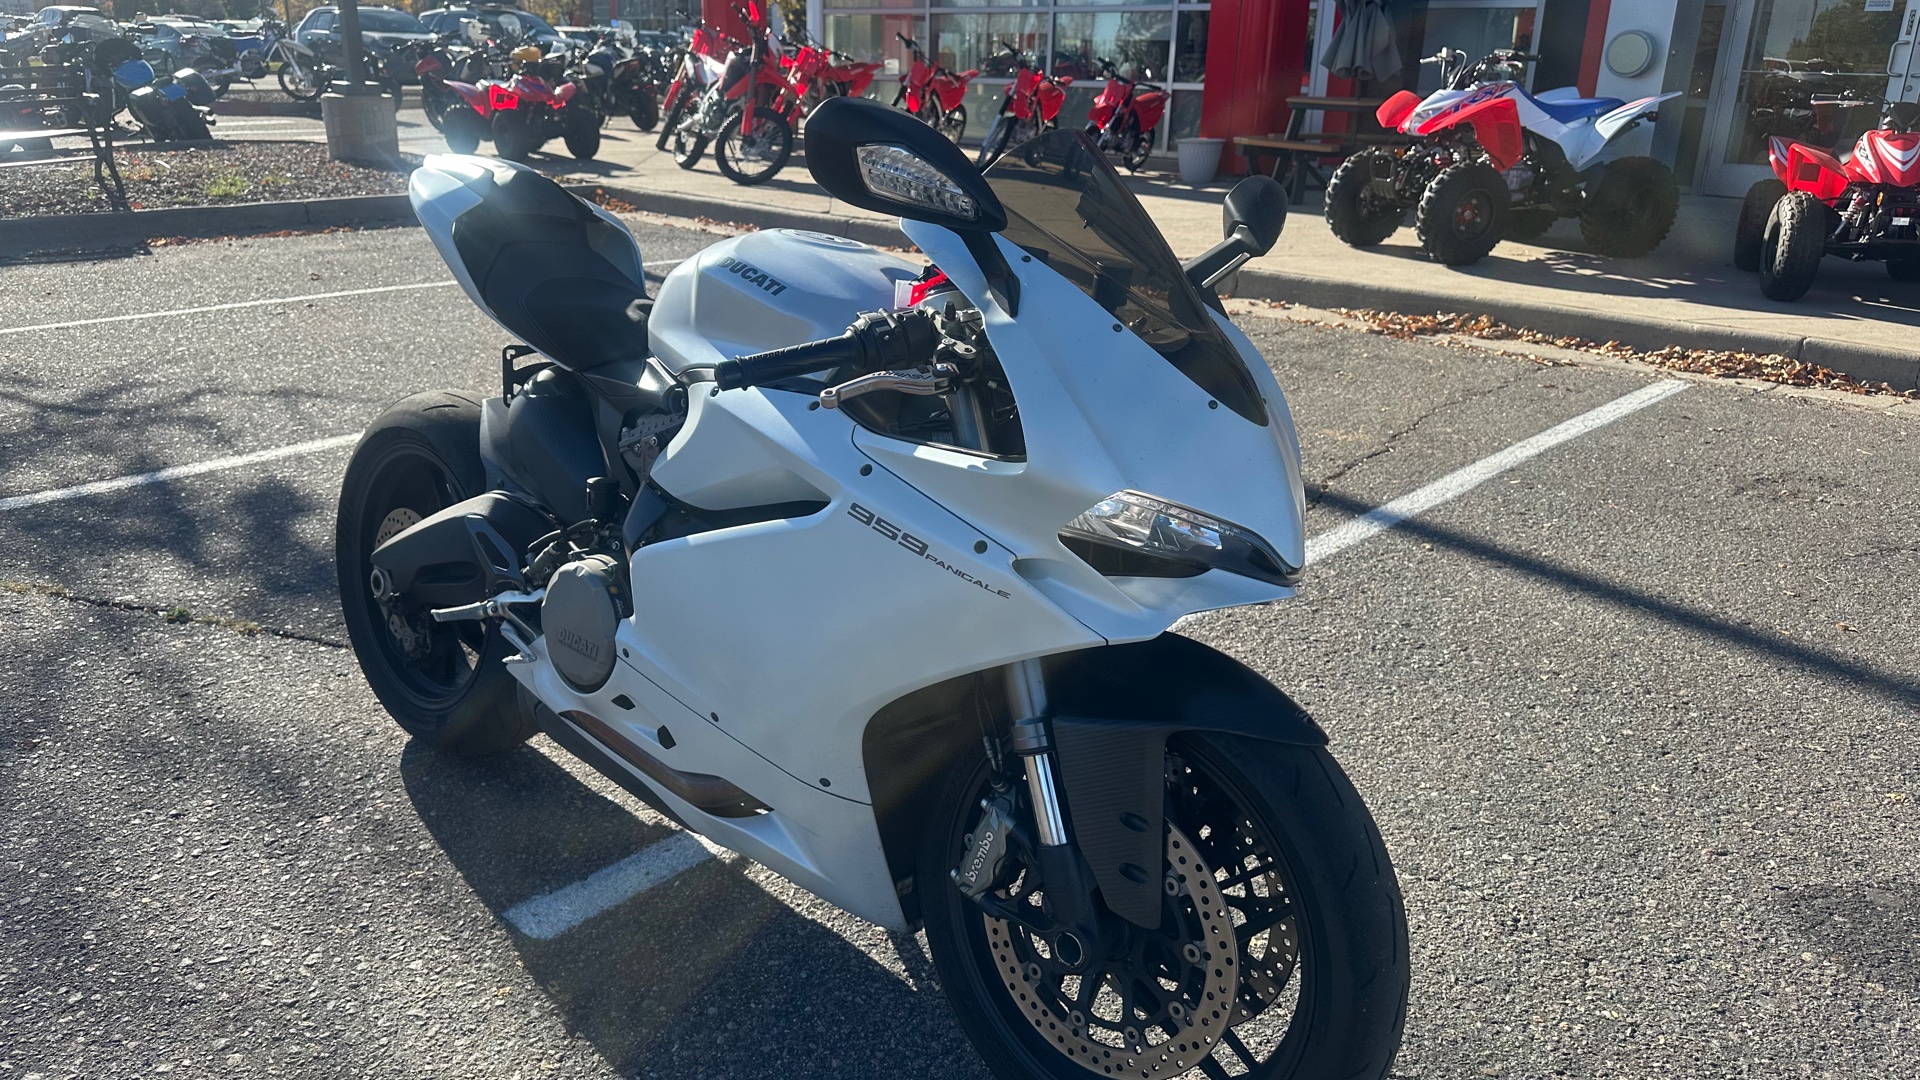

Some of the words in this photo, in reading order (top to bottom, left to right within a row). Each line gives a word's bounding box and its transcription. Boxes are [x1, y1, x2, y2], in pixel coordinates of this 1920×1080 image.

[717, 256, 787, 296] DUCATI
[847, 502, 929, 557] 959
[925, 553, 1011, 599] PANIGALE
[559, 628, 599, 657] DUCATI
[965, 831, 994, 883] brembo
